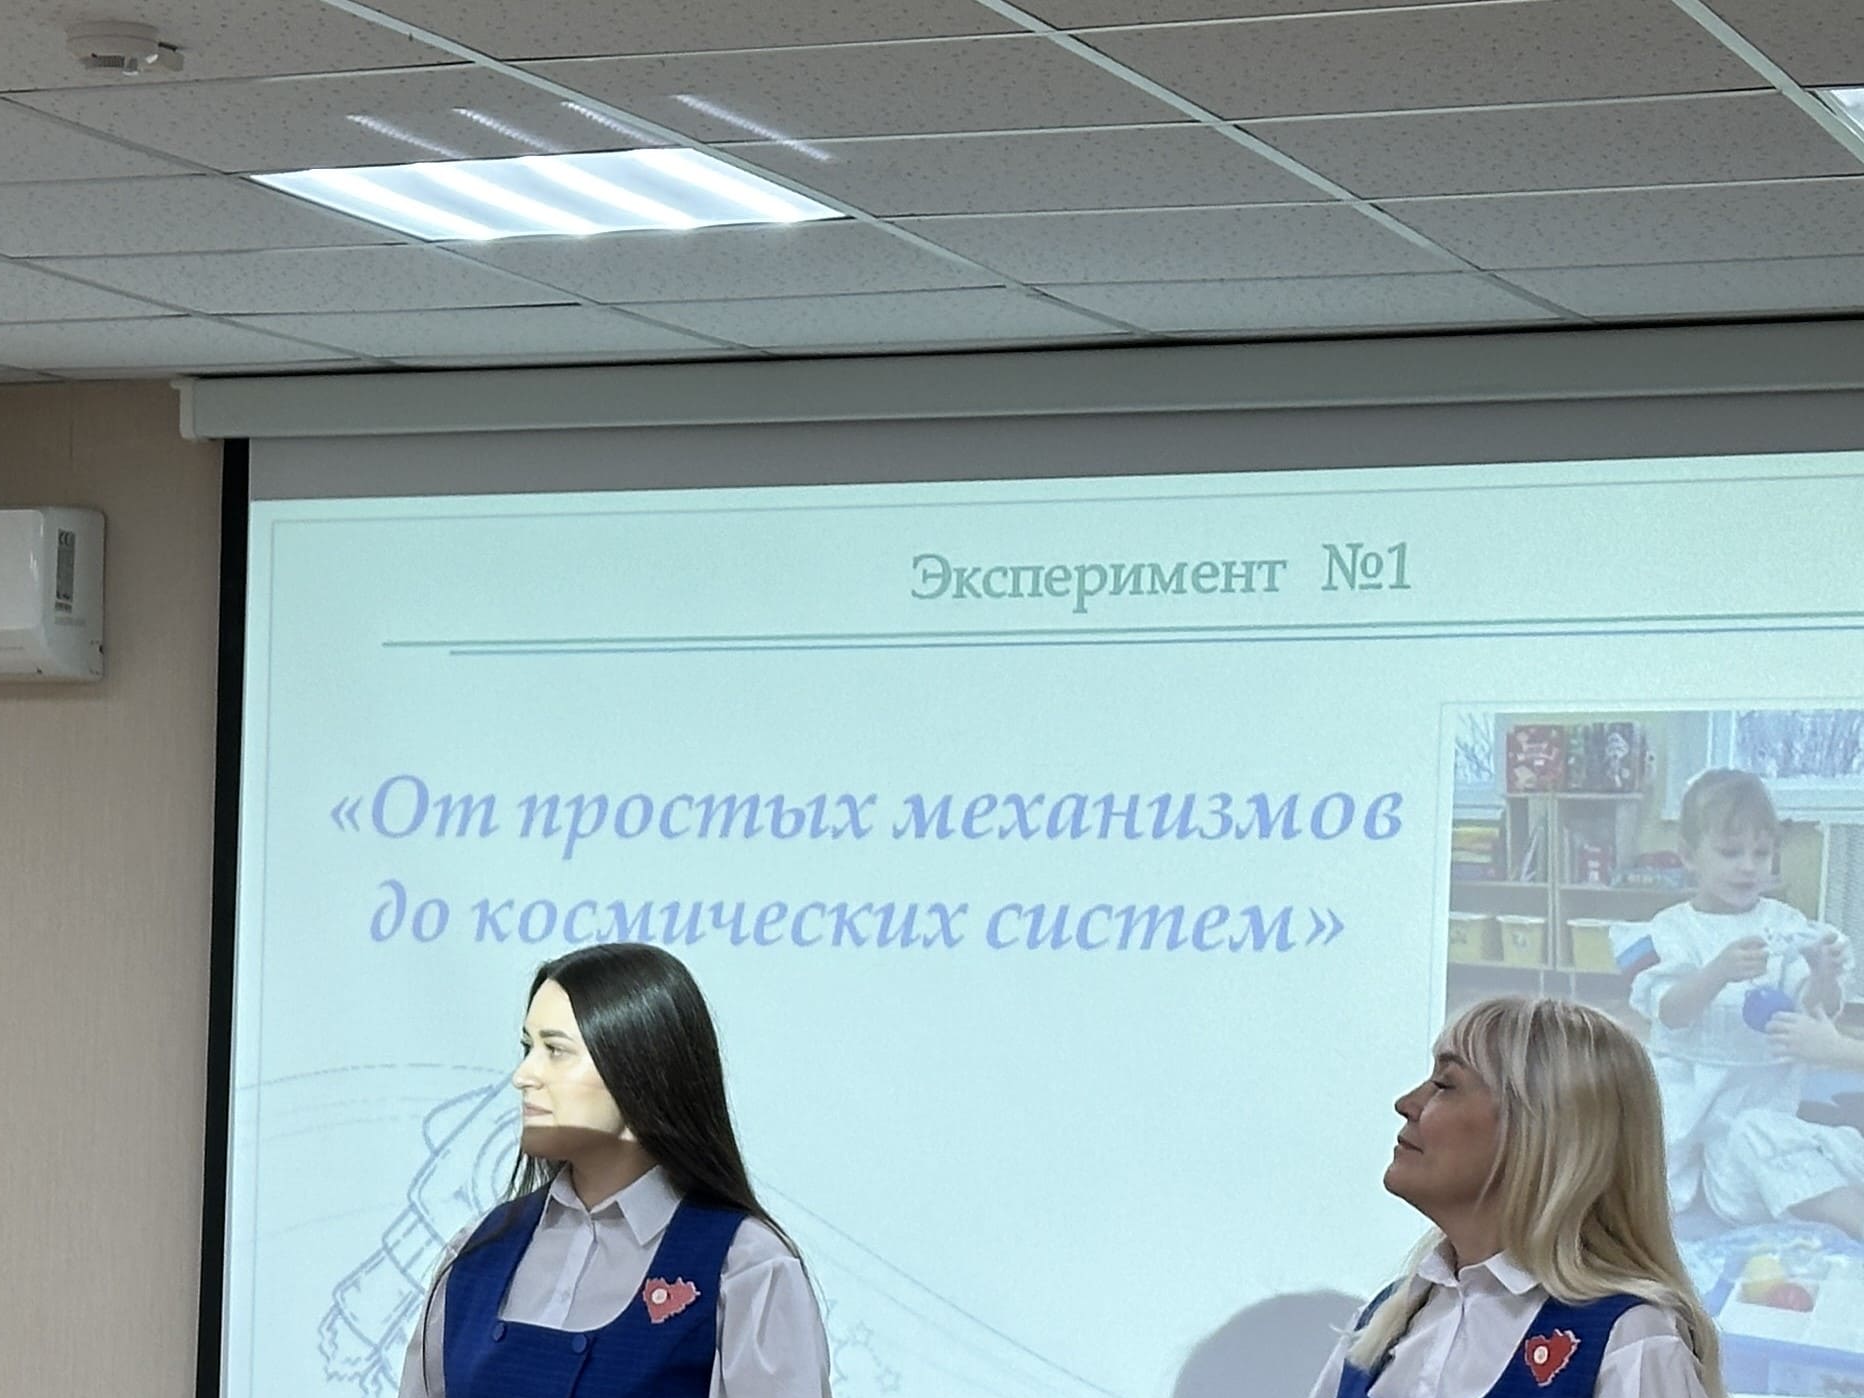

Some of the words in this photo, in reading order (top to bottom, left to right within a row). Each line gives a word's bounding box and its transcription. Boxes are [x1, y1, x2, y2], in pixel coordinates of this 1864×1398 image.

[910, 552, 1289, 615] Эксперимент
[1320, 541, 1412, 592] №1
[329, 772, 501, 841] «От
[516, 791, 879, 862] простых
[891, 790, 1404, 842] механизмов
[369, 878, 450, 943] до
[471, 896, 970, 949] космических
[985, 900, 1346, 953] систем»
